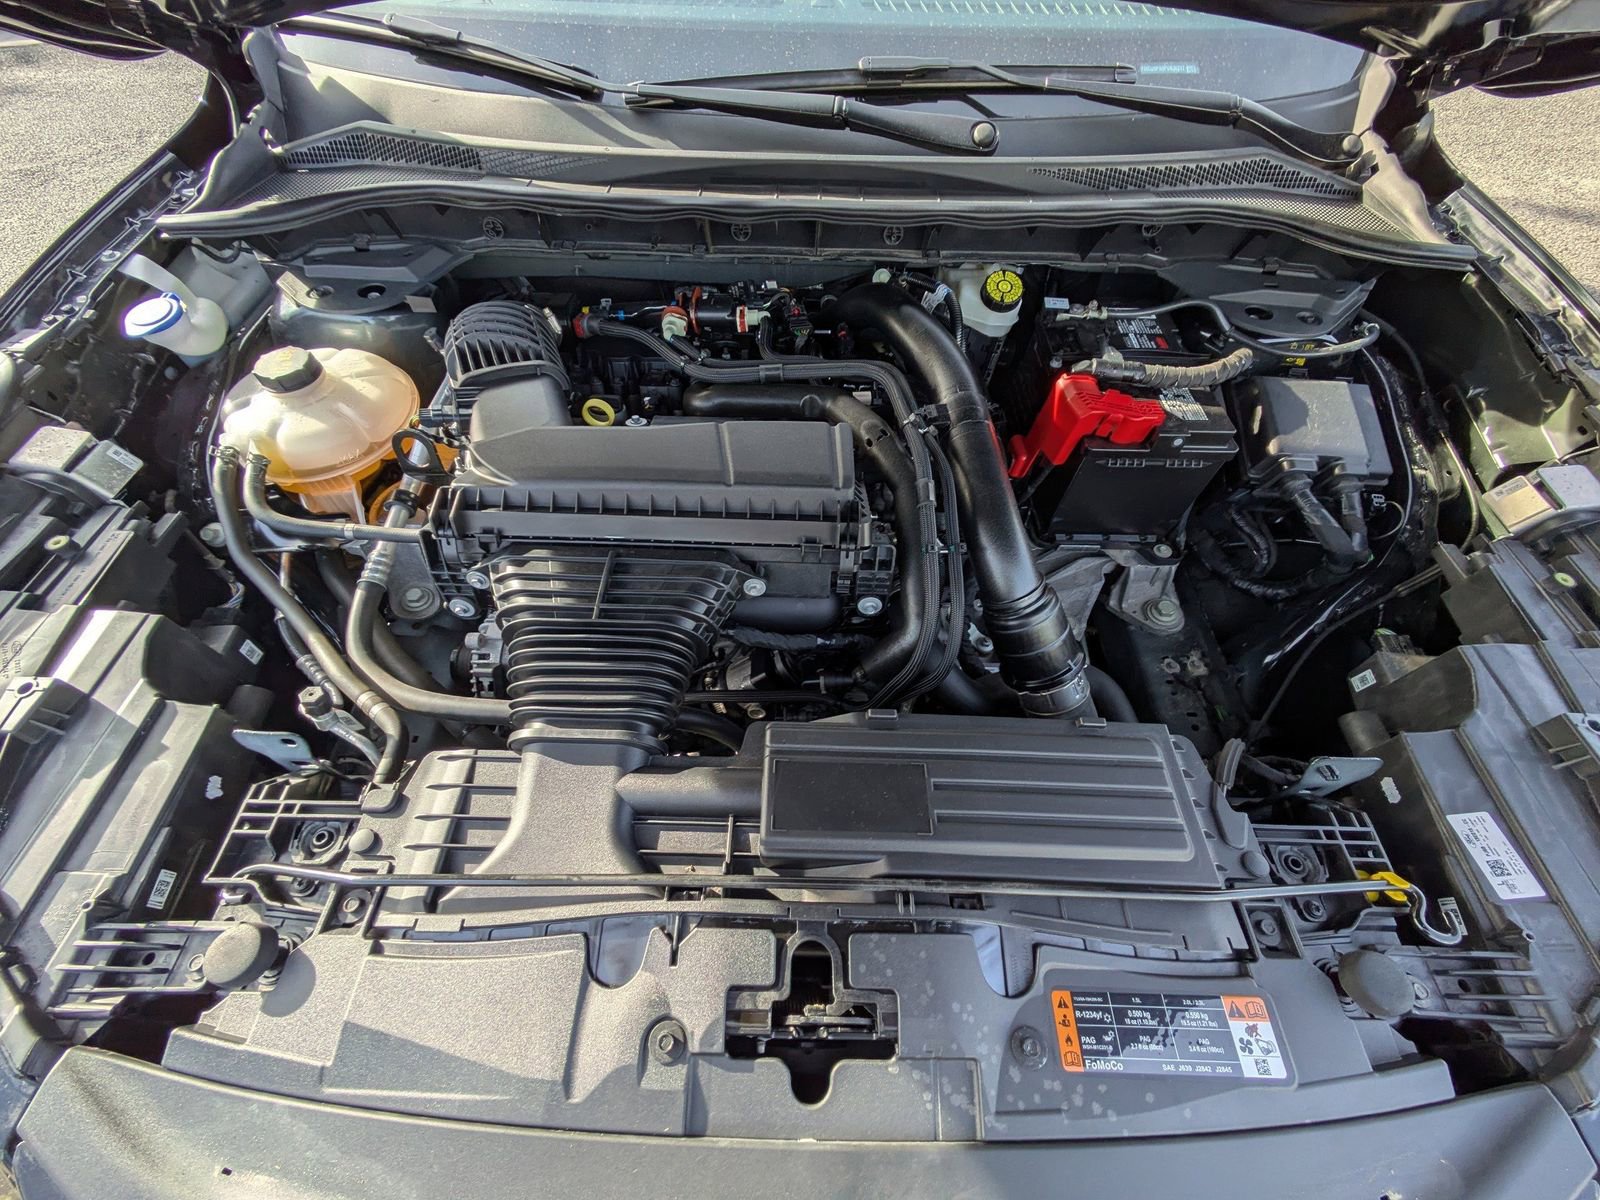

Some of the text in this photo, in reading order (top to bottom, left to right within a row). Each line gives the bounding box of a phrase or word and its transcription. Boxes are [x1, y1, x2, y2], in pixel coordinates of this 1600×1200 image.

[1142, 1010, 1151, 1019] kg
[1199, 1012, 1208, 1020] kg
[1084, 1059, 1123, 1070] FoMoCo
